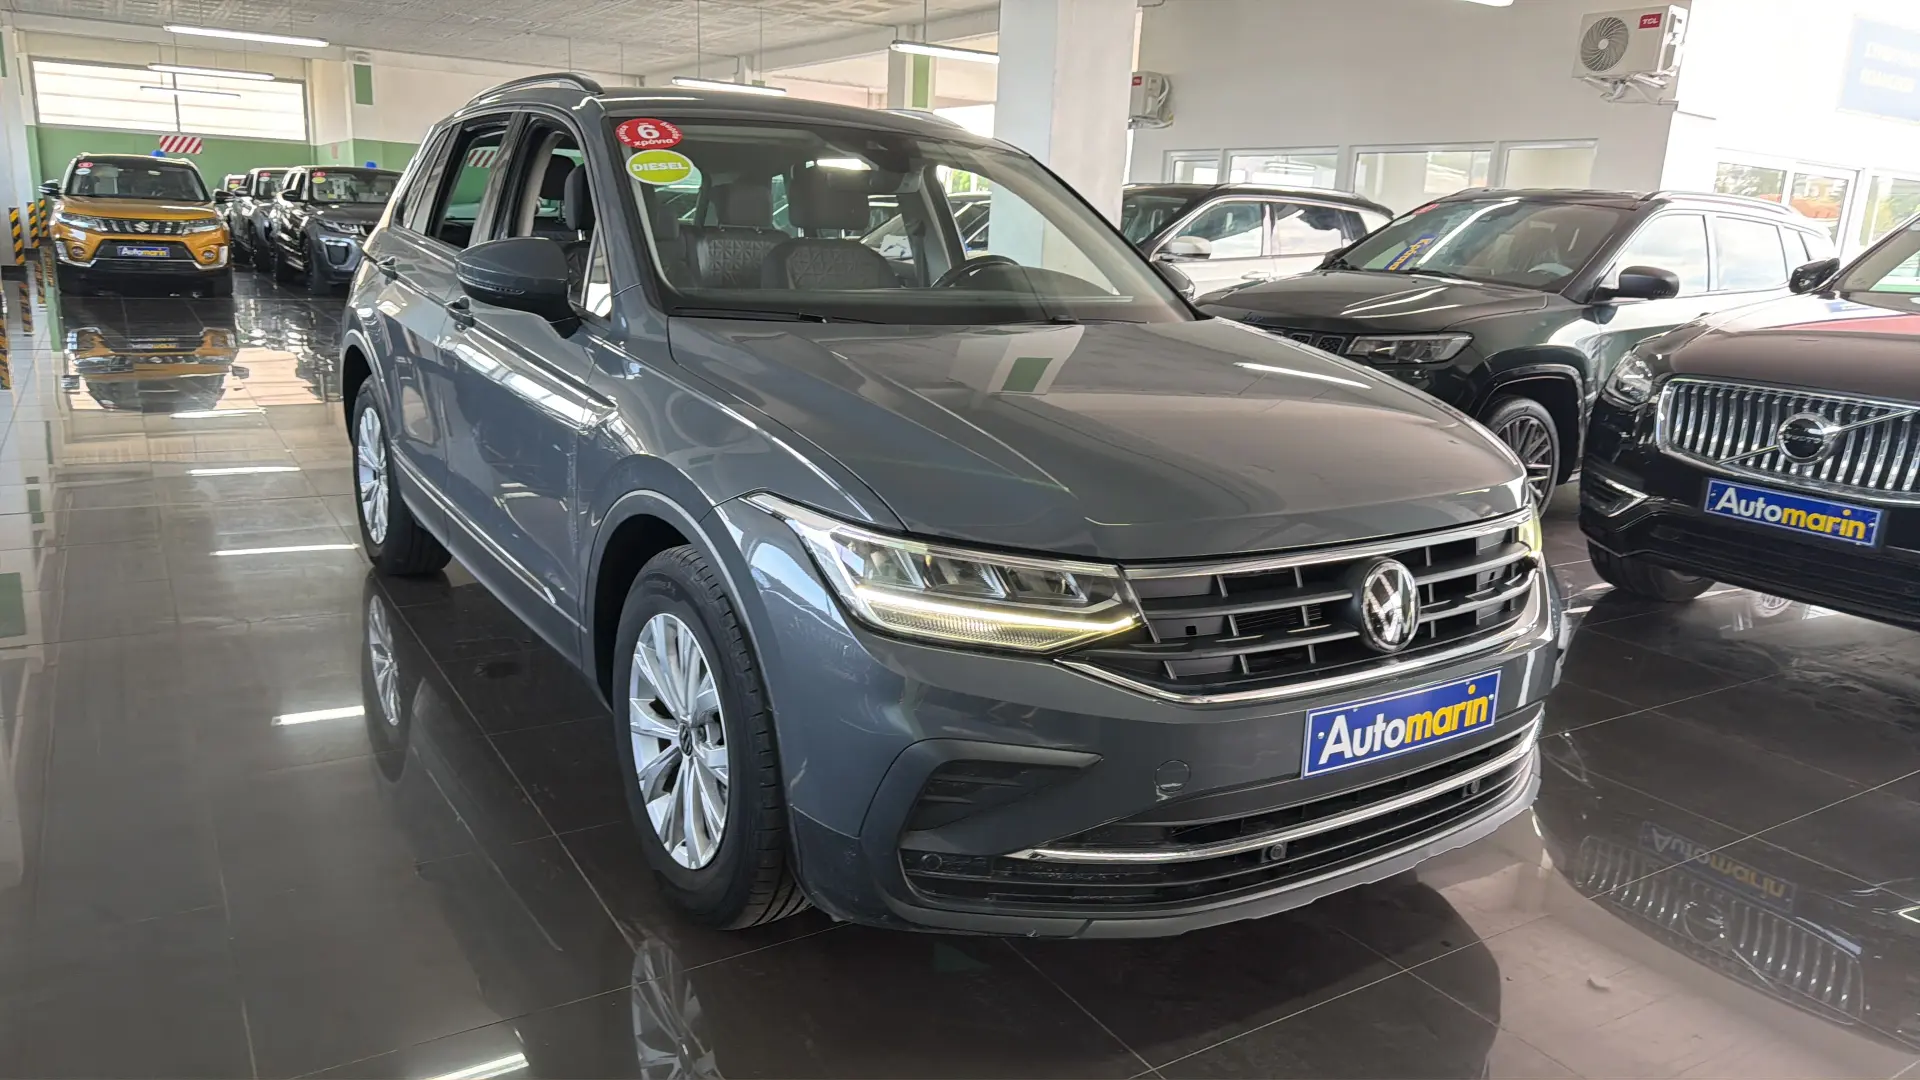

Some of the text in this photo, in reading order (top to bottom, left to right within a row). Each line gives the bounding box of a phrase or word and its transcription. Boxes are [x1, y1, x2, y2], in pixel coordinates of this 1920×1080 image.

[637, 124, 660, 139] 6
[633, 138, 674, 147] χρόνια
[632, 162, 689, 172] DIESEL
[121, 246, 167, 256] Automarin
[1714, 487, 1867, 540] Automarin
[1318, 684, 1489, 765] Automarin
